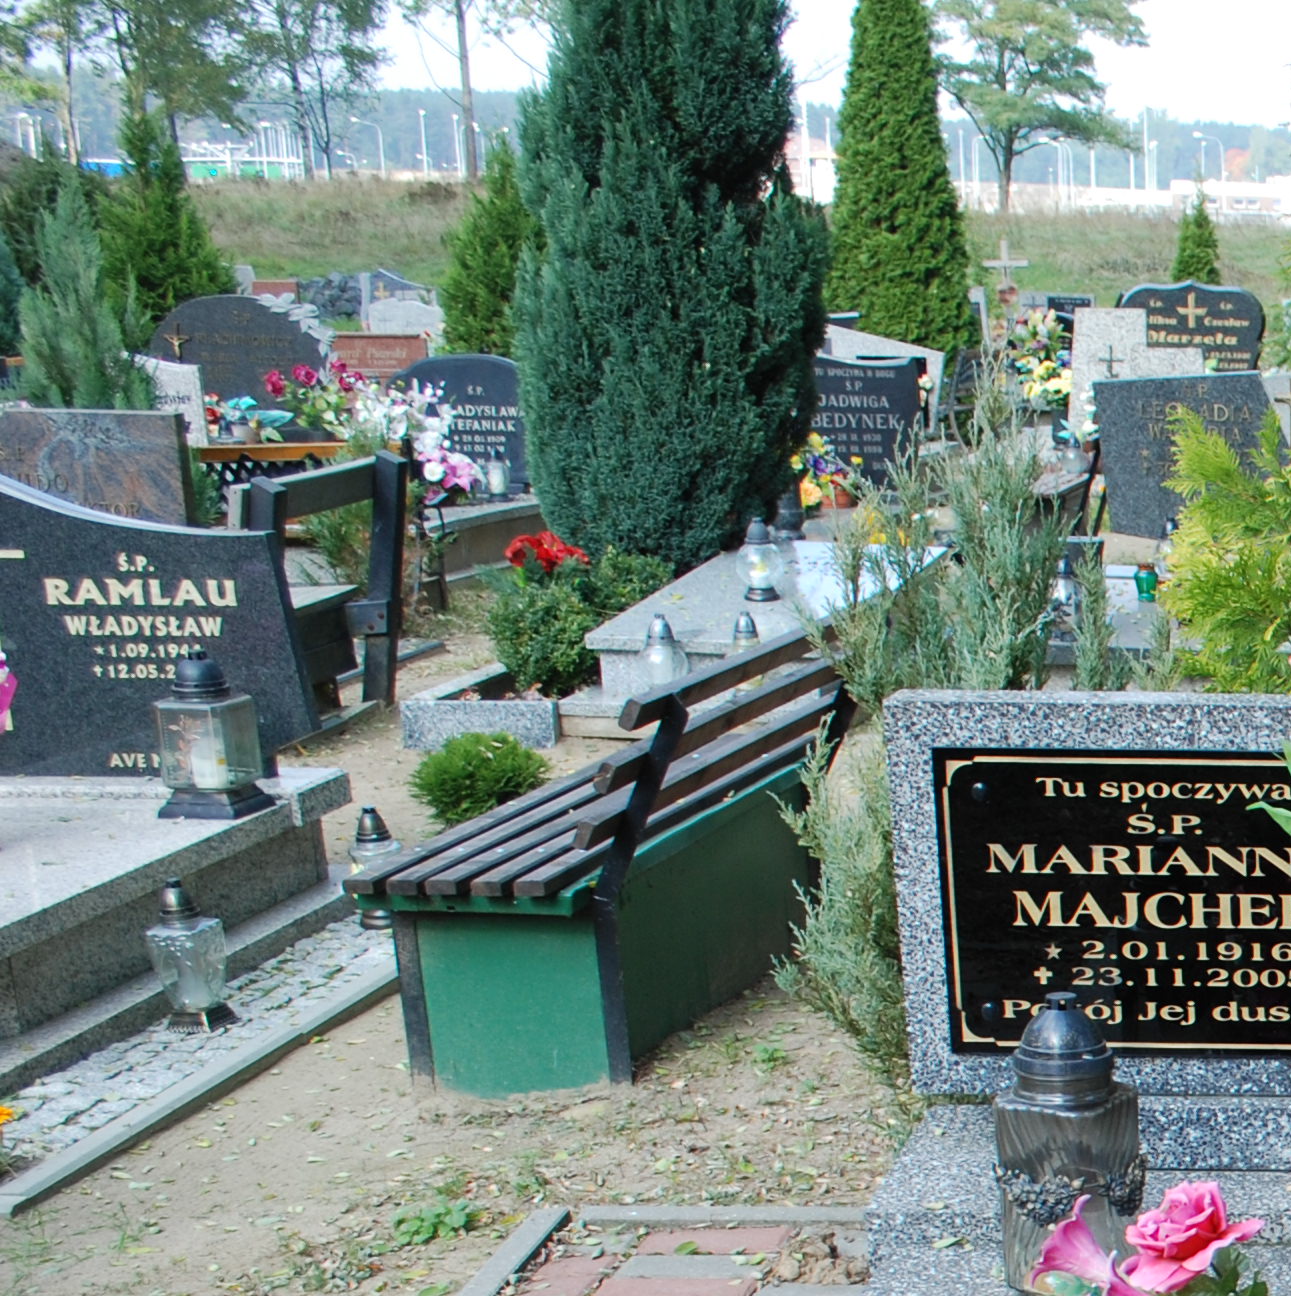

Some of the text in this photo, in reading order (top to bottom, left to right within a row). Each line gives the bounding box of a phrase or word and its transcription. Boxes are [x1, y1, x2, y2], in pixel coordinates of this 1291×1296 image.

[818, 394, 890, 408] JADWIGA
[811, 412, 900, 429] BEDYNEK
[1138, 401, 1251, 422] LEOADIA
[450, 420, 516, 432] TEFANIAK
[117, 552, 155, 572] Ś.P.
[43, 577, 238, 607] RAMLAU
[63, 614, 223, 637] WŁADYSŁAW
[108, 663, 177, 679] 12.05.2
[109, 752, 147, 768] AVE
[1035, 776, 1086, 798] Tu
[1126, 803, 1204, 835] Ś.P.
[1001, 998, 1123, 1025] Poój
[1138, 999, 1197, 1025] Jej
